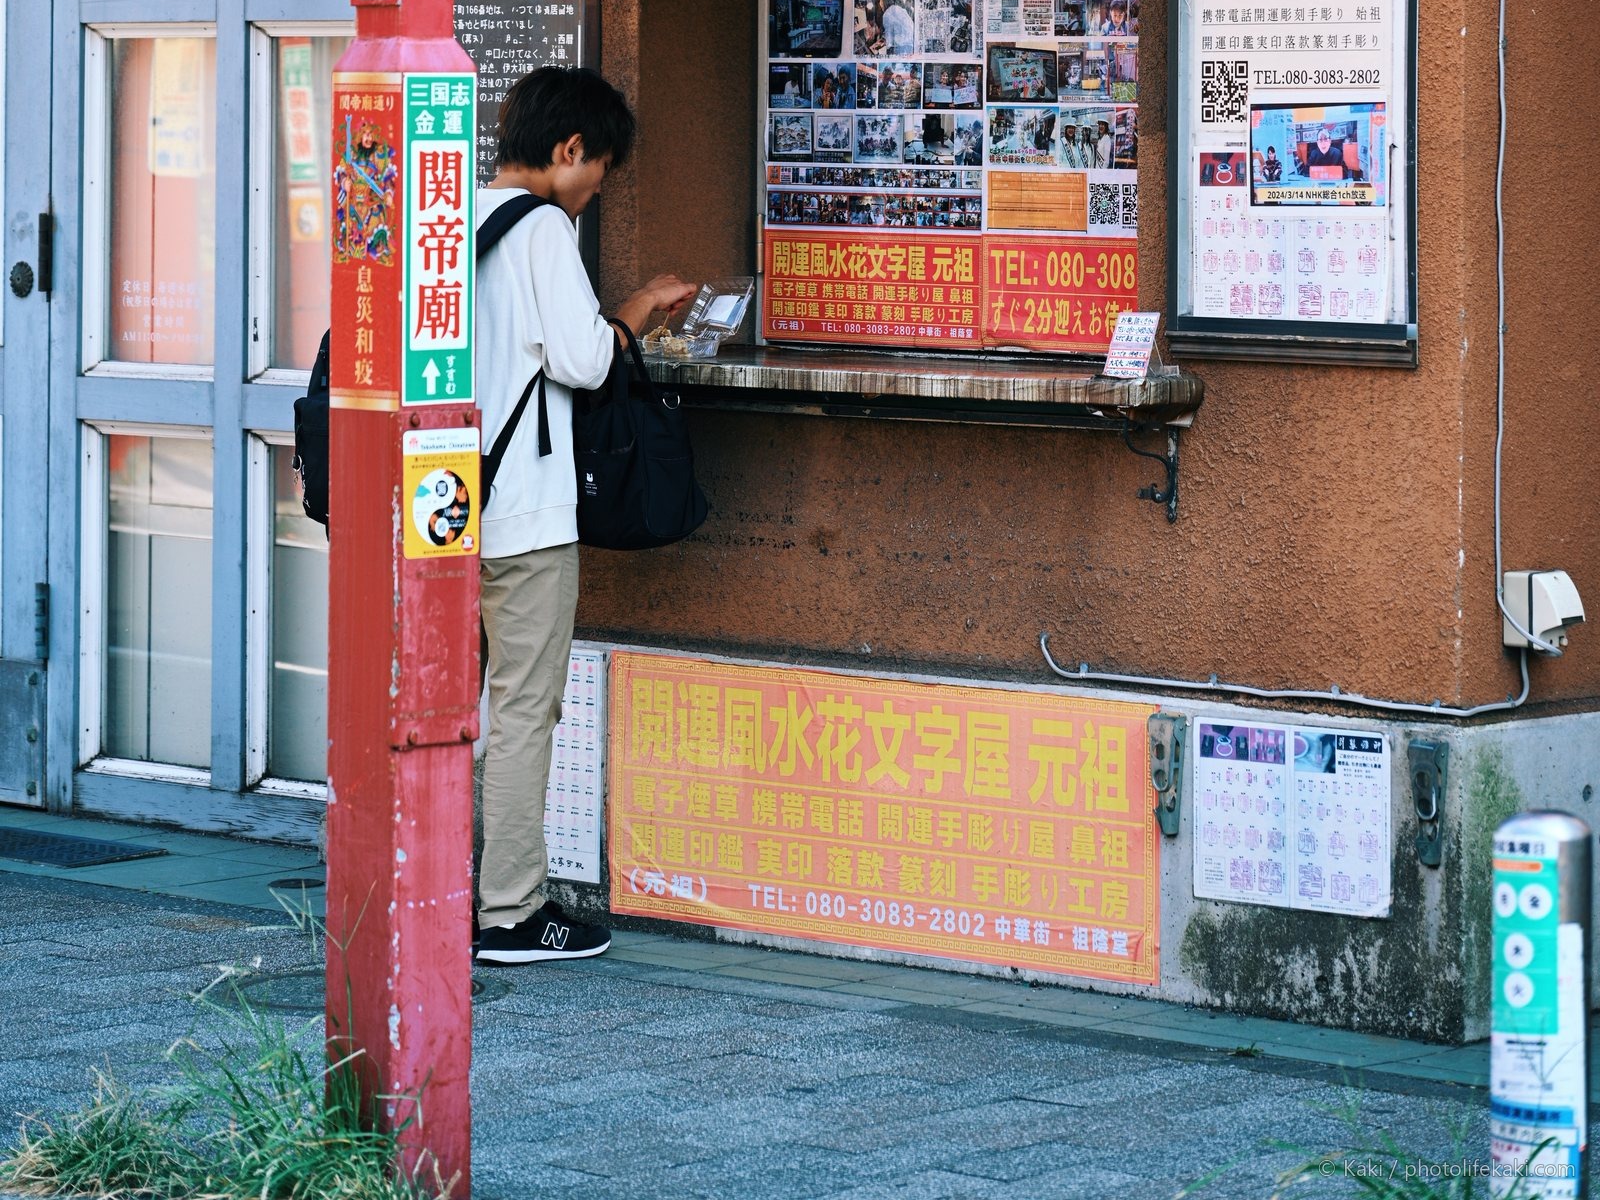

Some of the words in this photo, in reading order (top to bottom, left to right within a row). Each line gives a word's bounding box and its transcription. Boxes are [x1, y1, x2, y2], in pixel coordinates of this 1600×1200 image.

[1202, 7, 1344, 23] 携帯電話開運彫刻手彫り
[1356, 6, 1381, 21] 始祖
[1202, 34, 1379, 50] 開運印鑑実印落款篆刻手彫り
[1253, 70, 1381, 86] TEL:080-3083-2802
[339, 94, 395, 112] 関帝廟通り
[409, 81, 471, 108] 三国志
[414, 109, 464, 135] 金運
[1267, 190, 1304, 201] 2024/3/14
[414, 150, 465, 341] 関帝廟
[772, 240, 926, 280] 開運風水花文字屋
[932, 246, 974, 283] 元祖
[991, 249, 1038, 286] TEL:
[1046, 251, 1136, 290] 080-308
[772, 281, 818, 298] 電子煙草
[822, 283, 868, 301] 携帯電話
[873, 285, 944, 303] 開運手彫り屋
[949, 288, 974, 305] 鼻祖
[772, 300, 820, 316] 開運印鑑
[824, 303, 848, 319] 実印
[853, 305, 876, 321] 落款
[881, 305, 905, 322] 篆刻
[911, 307, 974, 325] 手彫り工房
[772, 320, 805, 332] (元祖)
[821, 322, 842, 333] TEL:
[844, 323, 916, 336] 080-3083-2802
[630, 677, 1012, 800] 開運風水花文字屋
[1027, 719, 1130, 814] 元祖
[630, 774, 741, 822] 電子煙草
[751, 787, 863, 839] 携帯電話
[877, 802, 1056, 860] 開運手彫り屋
[1070, 824, 1129, 869] 鼻祖
[630, 821, 744, 873] 開運印鑑
[757, 836, 813, 880] 実印
[826, 846, 885, 890] 落款
[899, 854, 957, 898] 篆刻
[972, 864, 1129, 920] 手彫り工房
[630, 867, 708, 902] (元祖)
[748, 883, 797, 912] TEL:
[805, 891, 985, 938] 080-3083-2802
